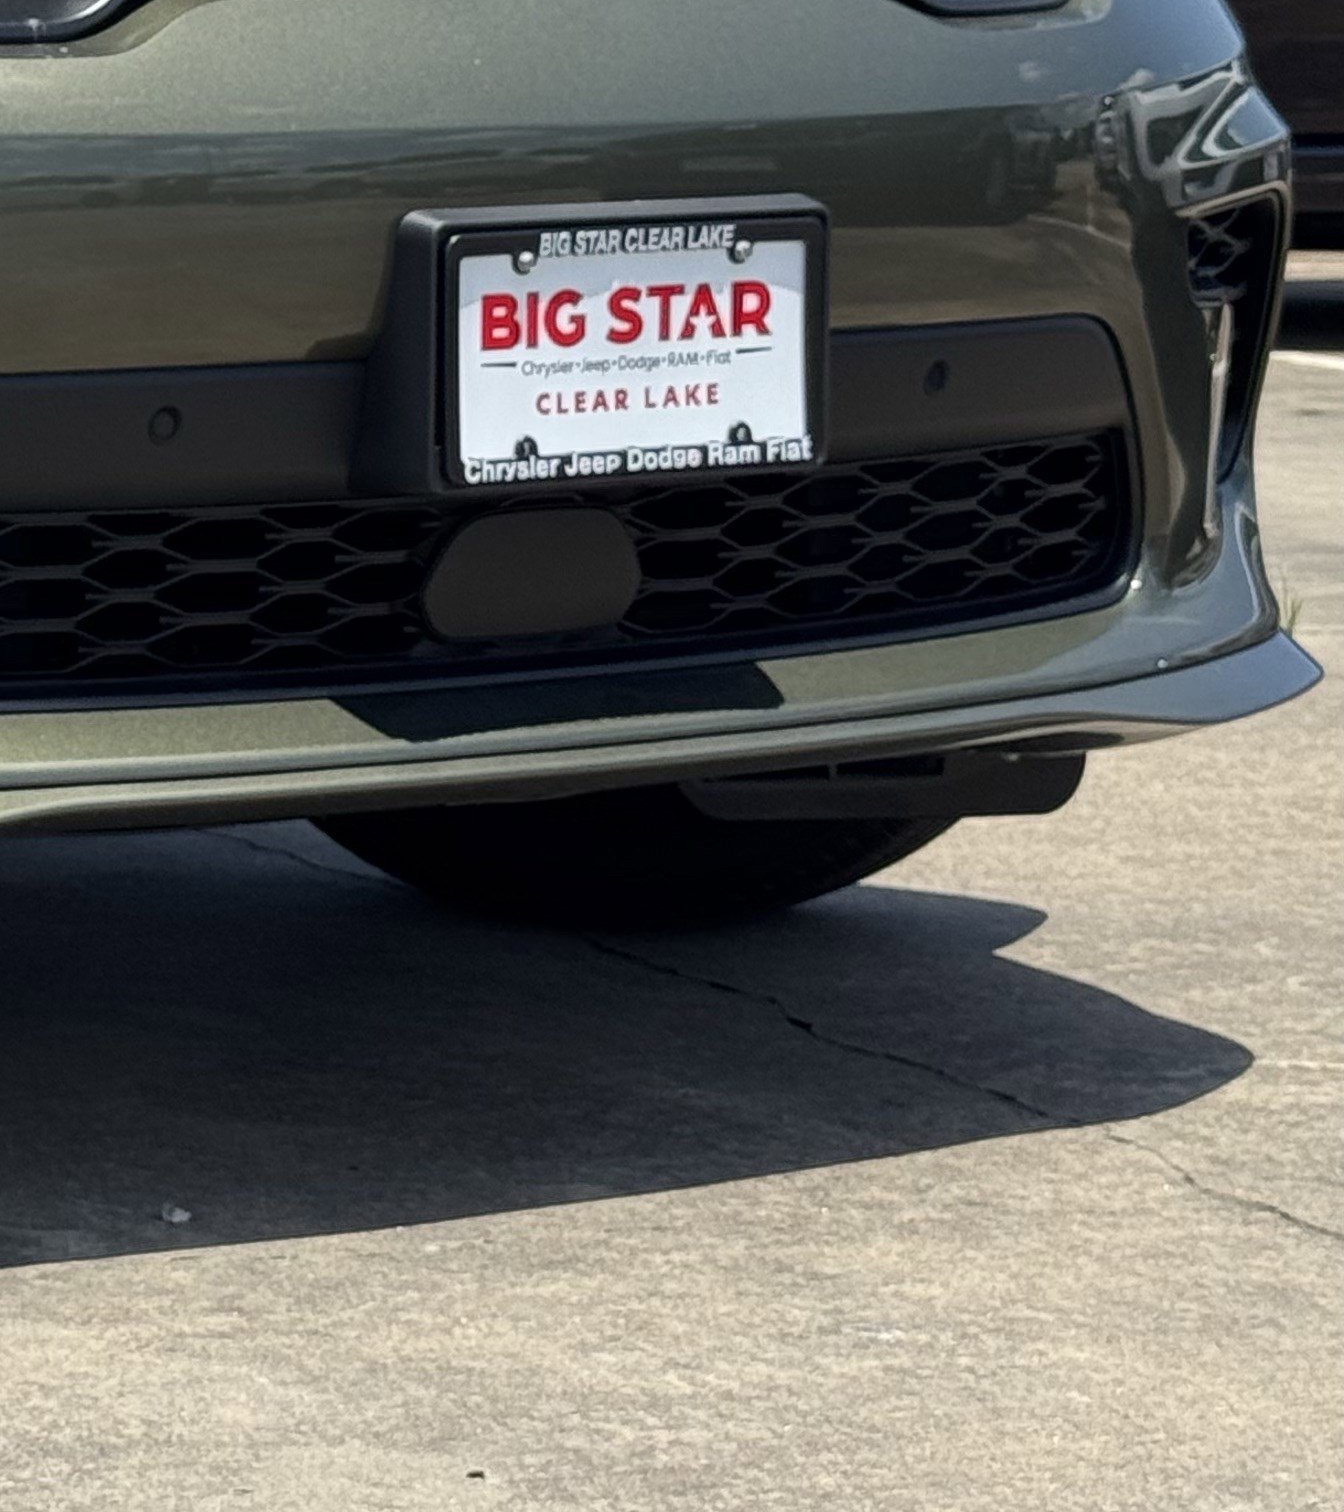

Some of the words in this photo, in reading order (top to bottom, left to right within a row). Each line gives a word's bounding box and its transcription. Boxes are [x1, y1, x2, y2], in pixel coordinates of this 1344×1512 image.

[539, 231, 573, 257] BIG
[574, 228, 622, 255] STAR
[624, 226, 684, 253] CLEAR
[687, 223, 736, 249] LAKE
[481, 288, 586, 351] BIG
[606, 280, 772, 345] STAR
[536, 388, 629, 416] CLEAR
[644, 383, 719, 409] LAKE
[464, 454, 561, 485] Chrysler
[564, 452, 622, 477] Jeep
[626, 445, 703, 473] Dodge
[707, 440, 762, 466] Ram
[766, 434, 813, 463] Fiat
